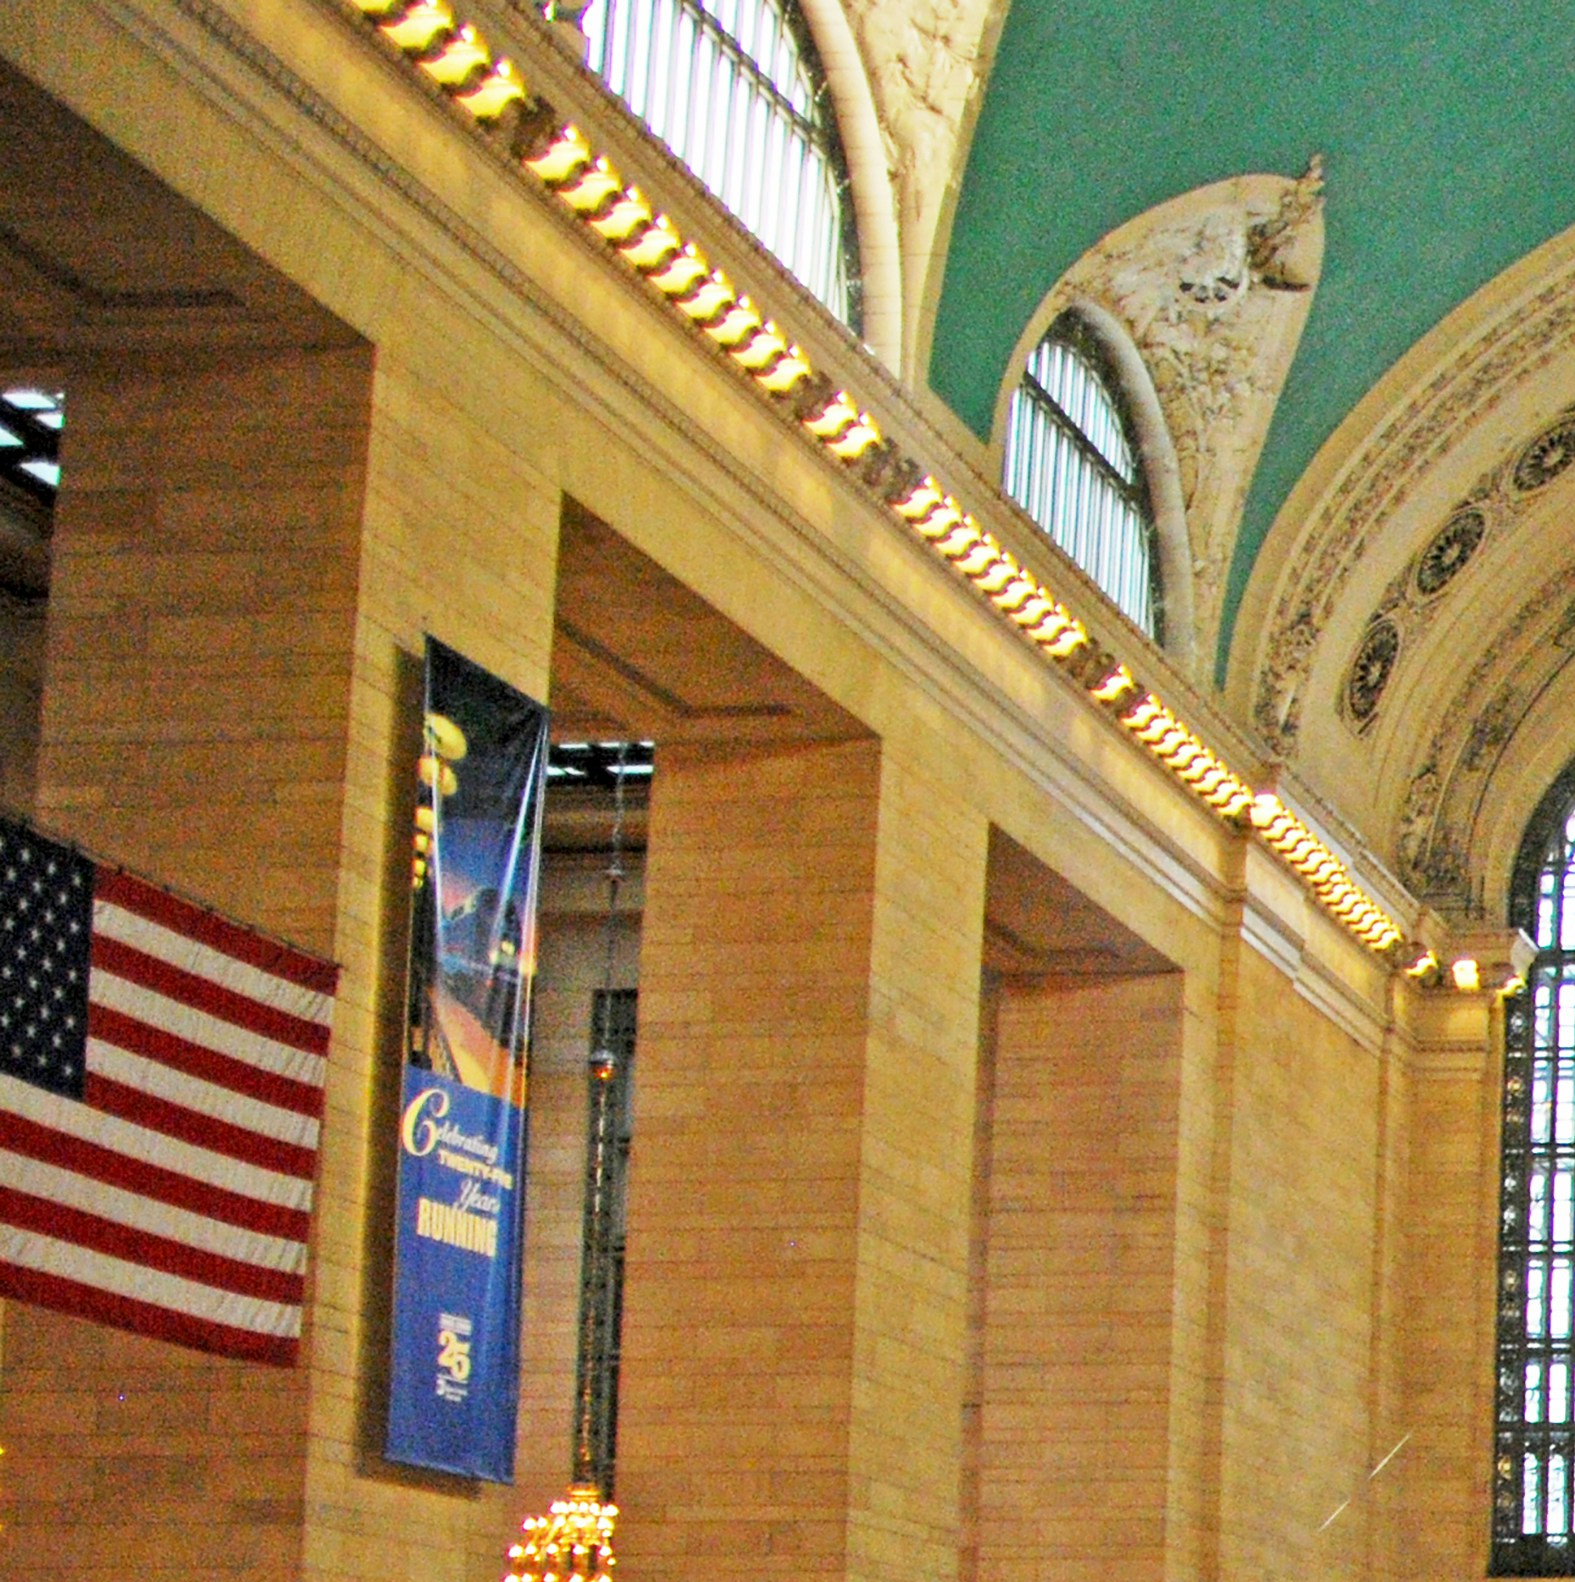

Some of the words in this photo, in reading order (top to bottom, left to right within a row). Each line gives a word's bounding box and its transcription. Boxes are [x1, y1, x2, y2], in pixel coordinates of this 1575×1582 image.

[402, 1088, 499, 1165] Celebrating
[416, 1197, 498, 1257] RUNNING
[437, 1330, 471, 1380] 25
